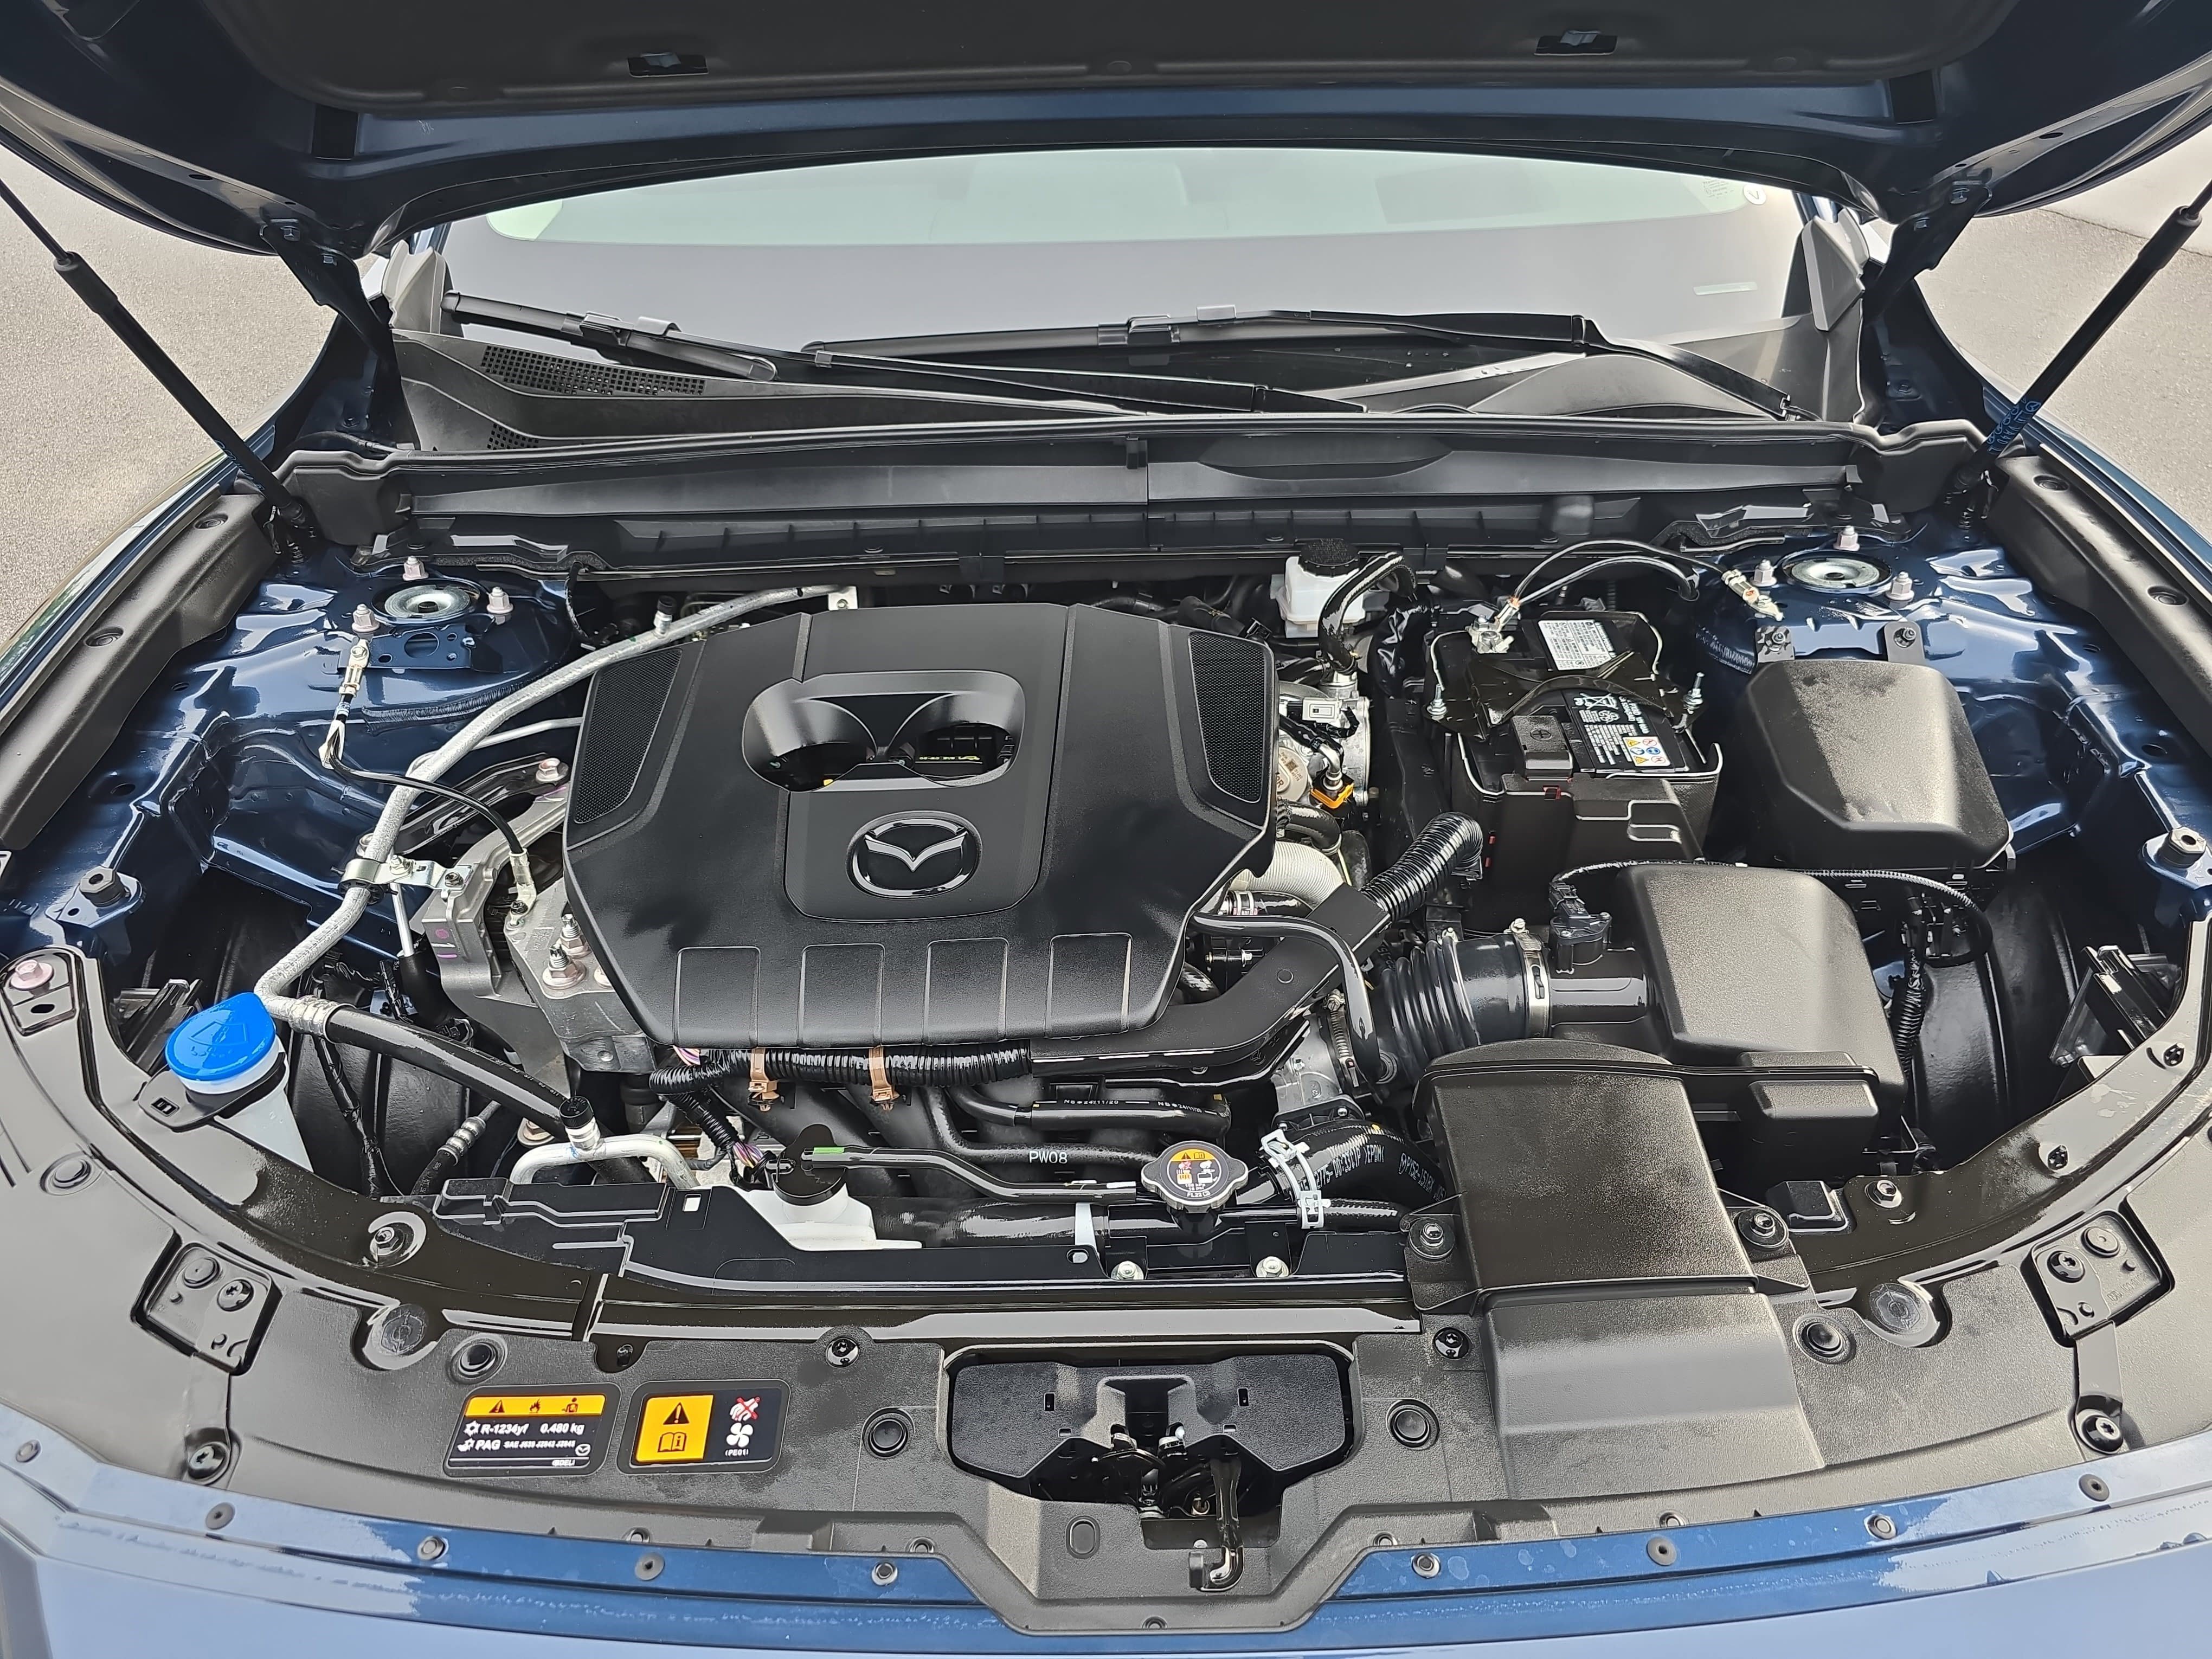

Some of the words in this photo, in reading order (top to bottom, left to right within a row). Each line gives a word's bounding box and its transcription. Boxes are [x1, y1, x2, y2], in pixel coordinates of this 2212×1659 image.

[1029, 1150, 1068, 1164] PW08
[539, 1423, 569, 1434] 0.480
[570, 1423, 585, 1436] kg
[475, 1439, 501, 1451] PAG
